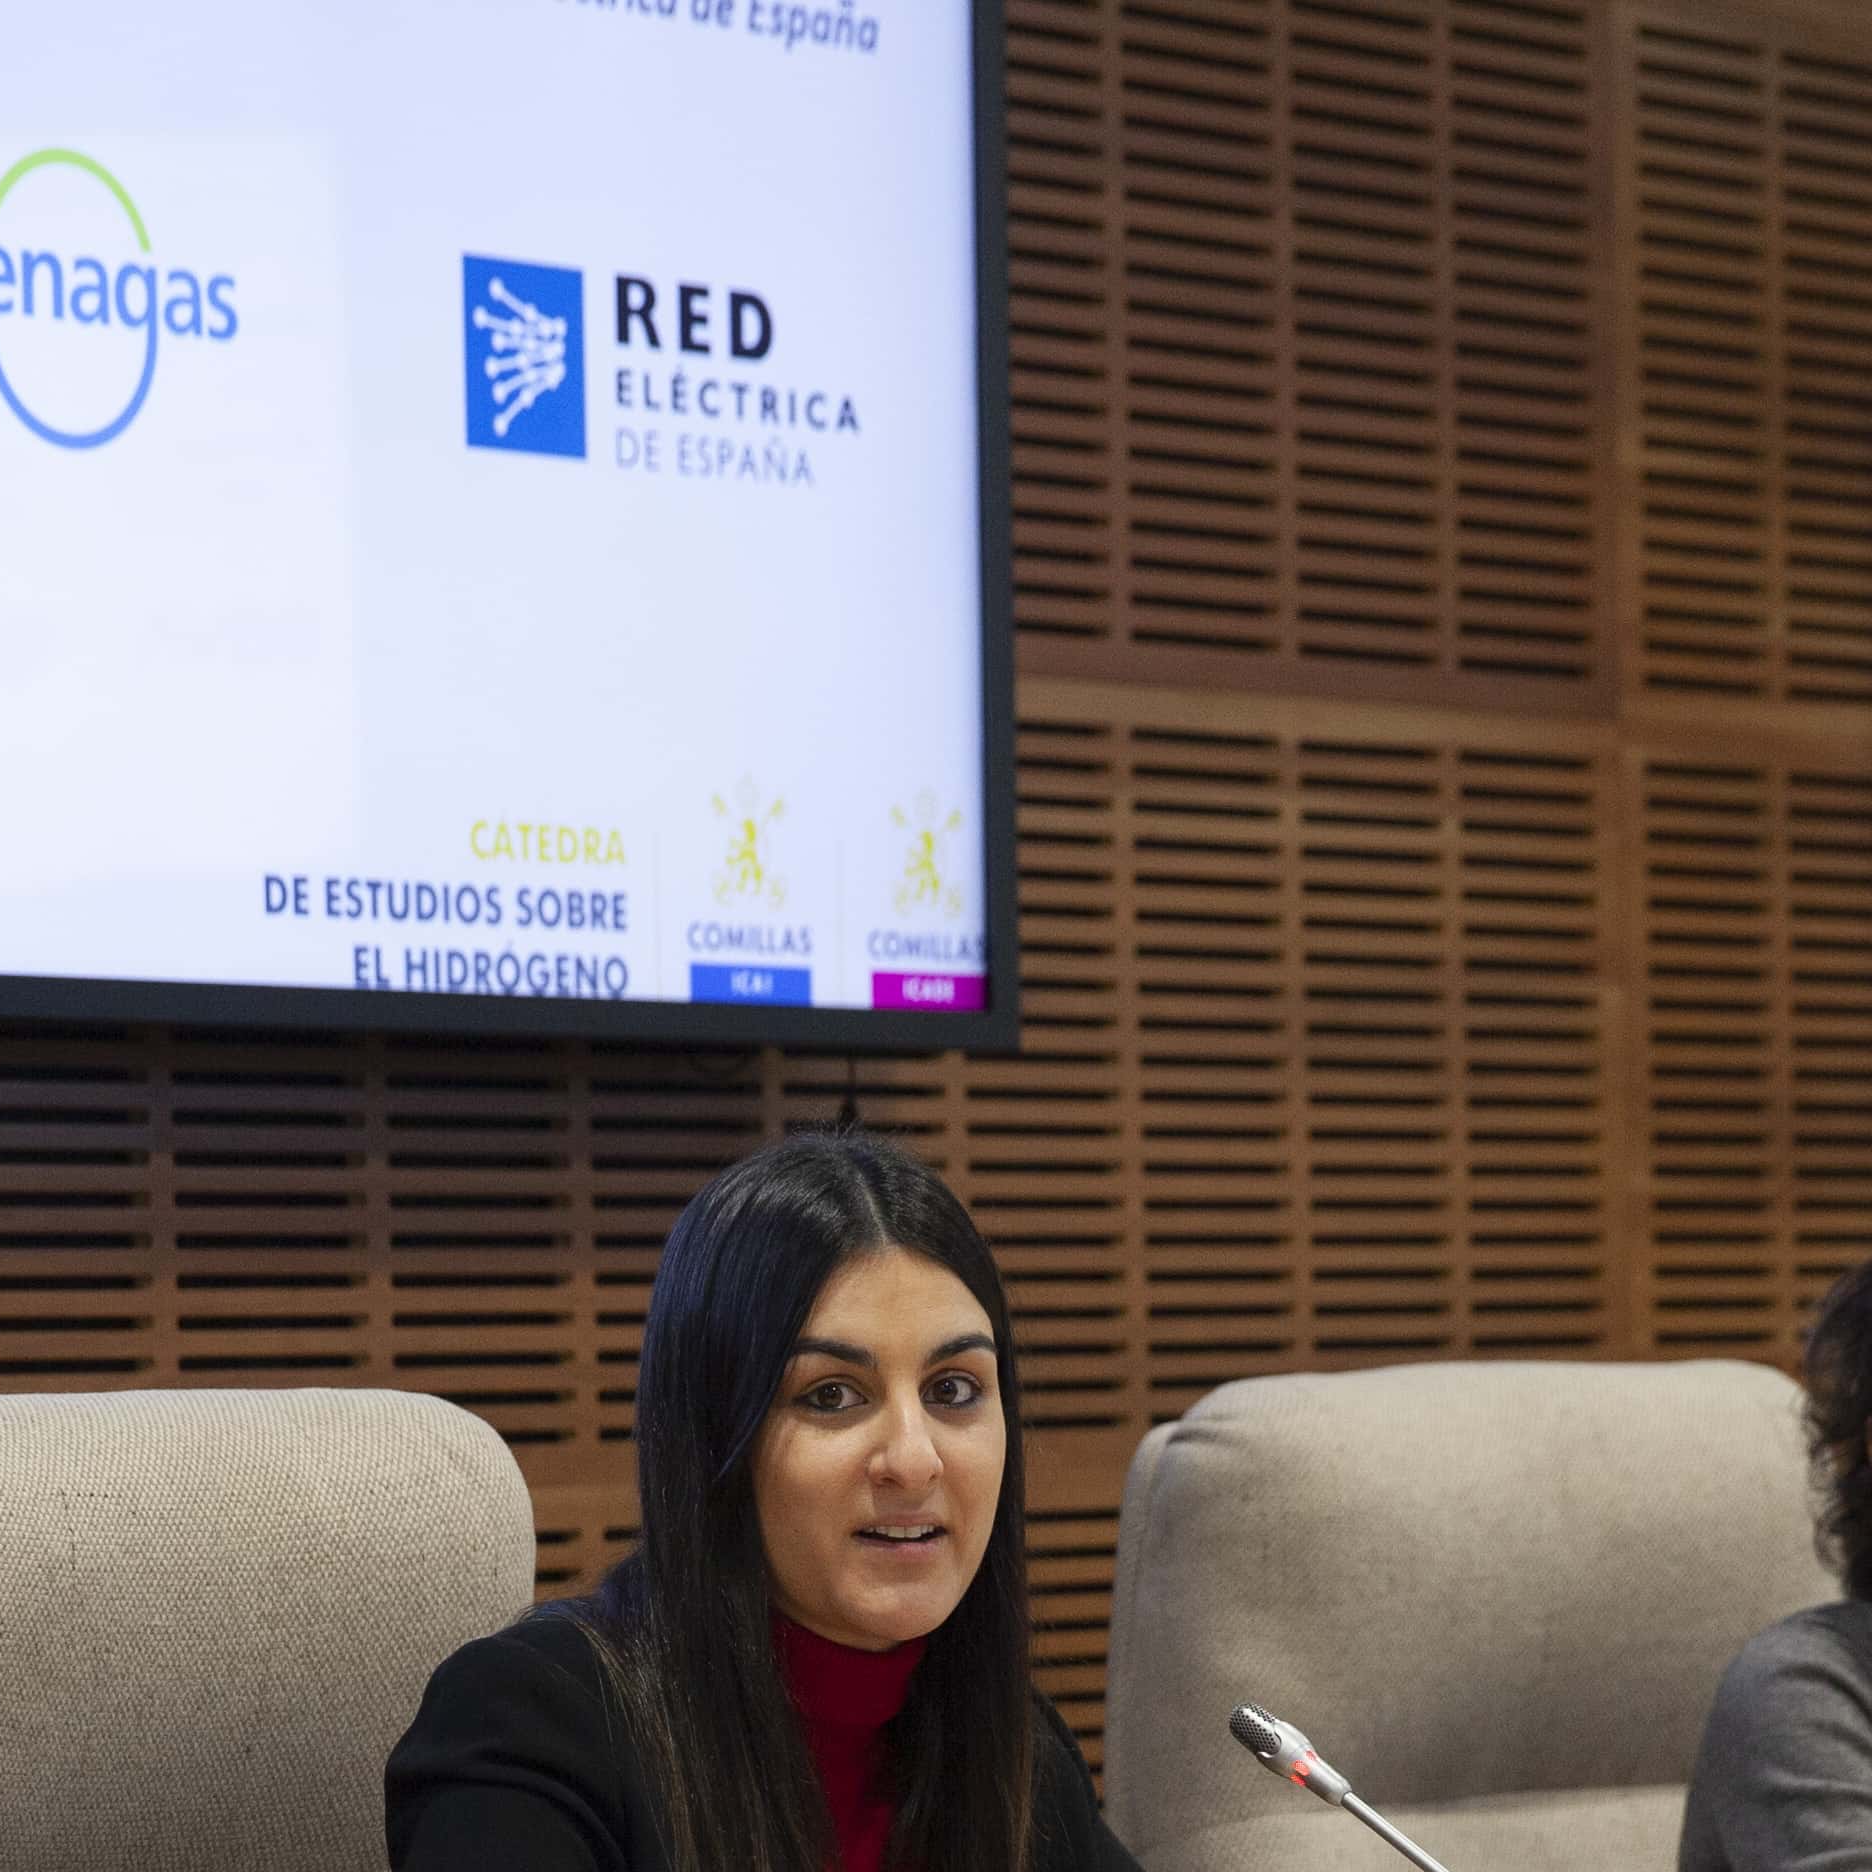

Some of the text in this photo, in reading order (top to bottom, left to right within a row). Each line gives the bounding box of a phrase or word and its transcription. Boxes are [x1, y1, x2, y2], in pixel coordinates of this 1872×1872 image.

[746, 0, 879, 52] España
[615, 275, 774, 361] RED
[616, 366, 860, 437] ELÉCTRICA
[615, 428, 816, 487] DE ESPAÑA
[264, 874, 628, 931] DE ESTUDIOS SOBRE
[687, 922, 813, 954] COMILLAS
[354, 945, 390, 990] EL
